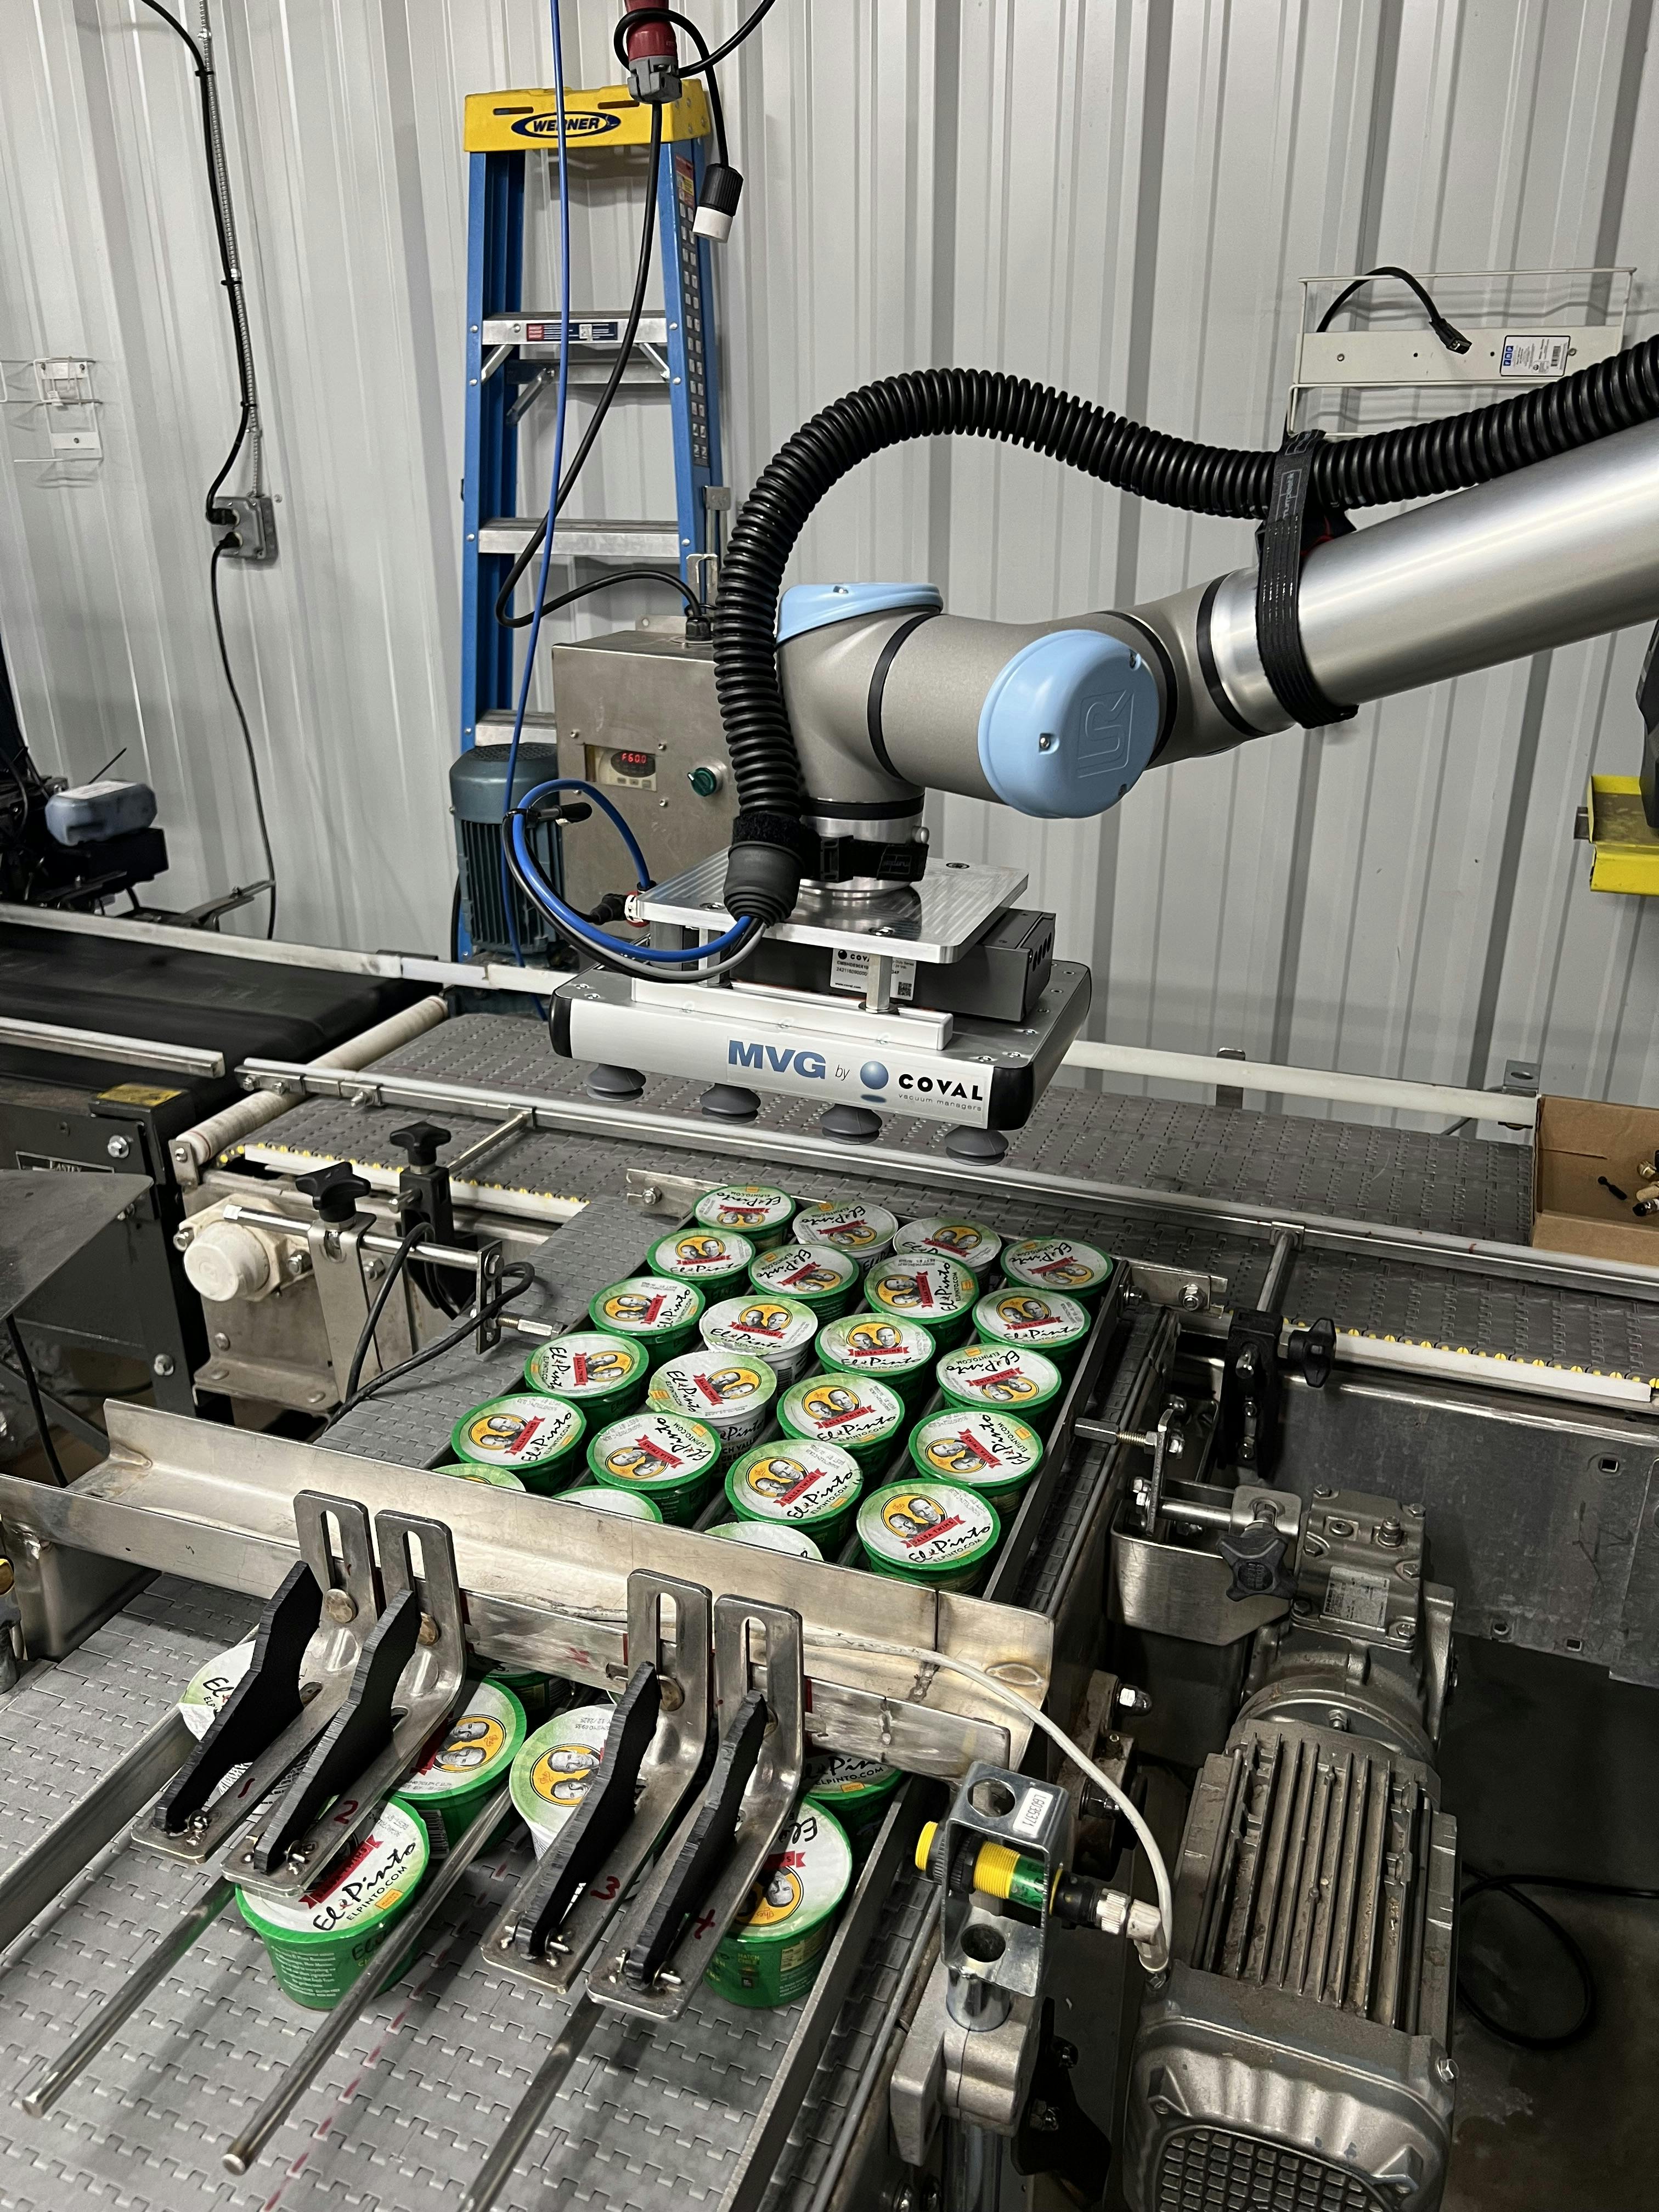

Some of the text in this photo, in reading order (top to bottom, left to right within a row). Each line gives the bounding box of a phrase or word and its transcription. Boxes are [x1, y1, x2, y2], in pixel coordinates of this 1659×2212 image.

[533, 117, 600, 132] WENER
[850, 953, 870, 962] COV
[728, 1040, 983, 1101] MVG by COVAL
[899, 1093, 982, 1112] vacuum managers
[716, 1192, 781, 1206] El Pinto
[802, 1206, 866, 1225] El Pinto
[795, 1249, 811, 1262] El
[1009, 1242, 1072, 1265] El Pinto
[757, 1261, 798, 1278] Pinto
[934, 1262, 952, 1295] Pinto
[661, 1289, 690, 1317] Pinto
[939, 1300, 958, 1311] El
[710, 1328, 731, 1338] El
[736, 1334, 782, 1348] Pinto
[1029, 1327, 1080, 1339] Pinto
[548, 1347, 571, 1390] El Pinto
[841, 1357, 922, 1367] El Pinto
[946, 1350, 1020, 1375] El Pinto
[667, 1371, 702, 1412] El Pinto
[530, 1412, 572, 1447] Pinto
[654, 1418, 691, 1453] Pinto
[673, 1422, 707, 1448] ELPINTO.COM
[817, 1416, 896, 1441] El Pinto
[838, 1426, 885, 1442] ELPINTO.COM
[979, 1414, 1031, 1465] El Pinto
[997, 1422, 1028, 1453] ELPINTO.COM
[521, 1451, 541, 1462] El
[686, 1448, 712, 1461] El
[787, 1471, 853, 1519] El Pinto
[810, 1485, 849, 1514] ELPINTO.COM
[909, 1526, 991, 1563] El Pinto
[933, 1538, 983, 1563] ELPINTO.COM
[202, 1677, 235, 1697] El
[815, 1767, 884, 1786] ELPINTO.COM
[828, 1756, 875, 1776] Pin
[333, 1800, 359, 1825] 2
[788, 1816, 818, 1844] El
[313, 1842, 416, 1931] El Pinto
[346, 1865, 408, 1921] ELPINTO.COM
[590, 1876, 620, 1900] 3
